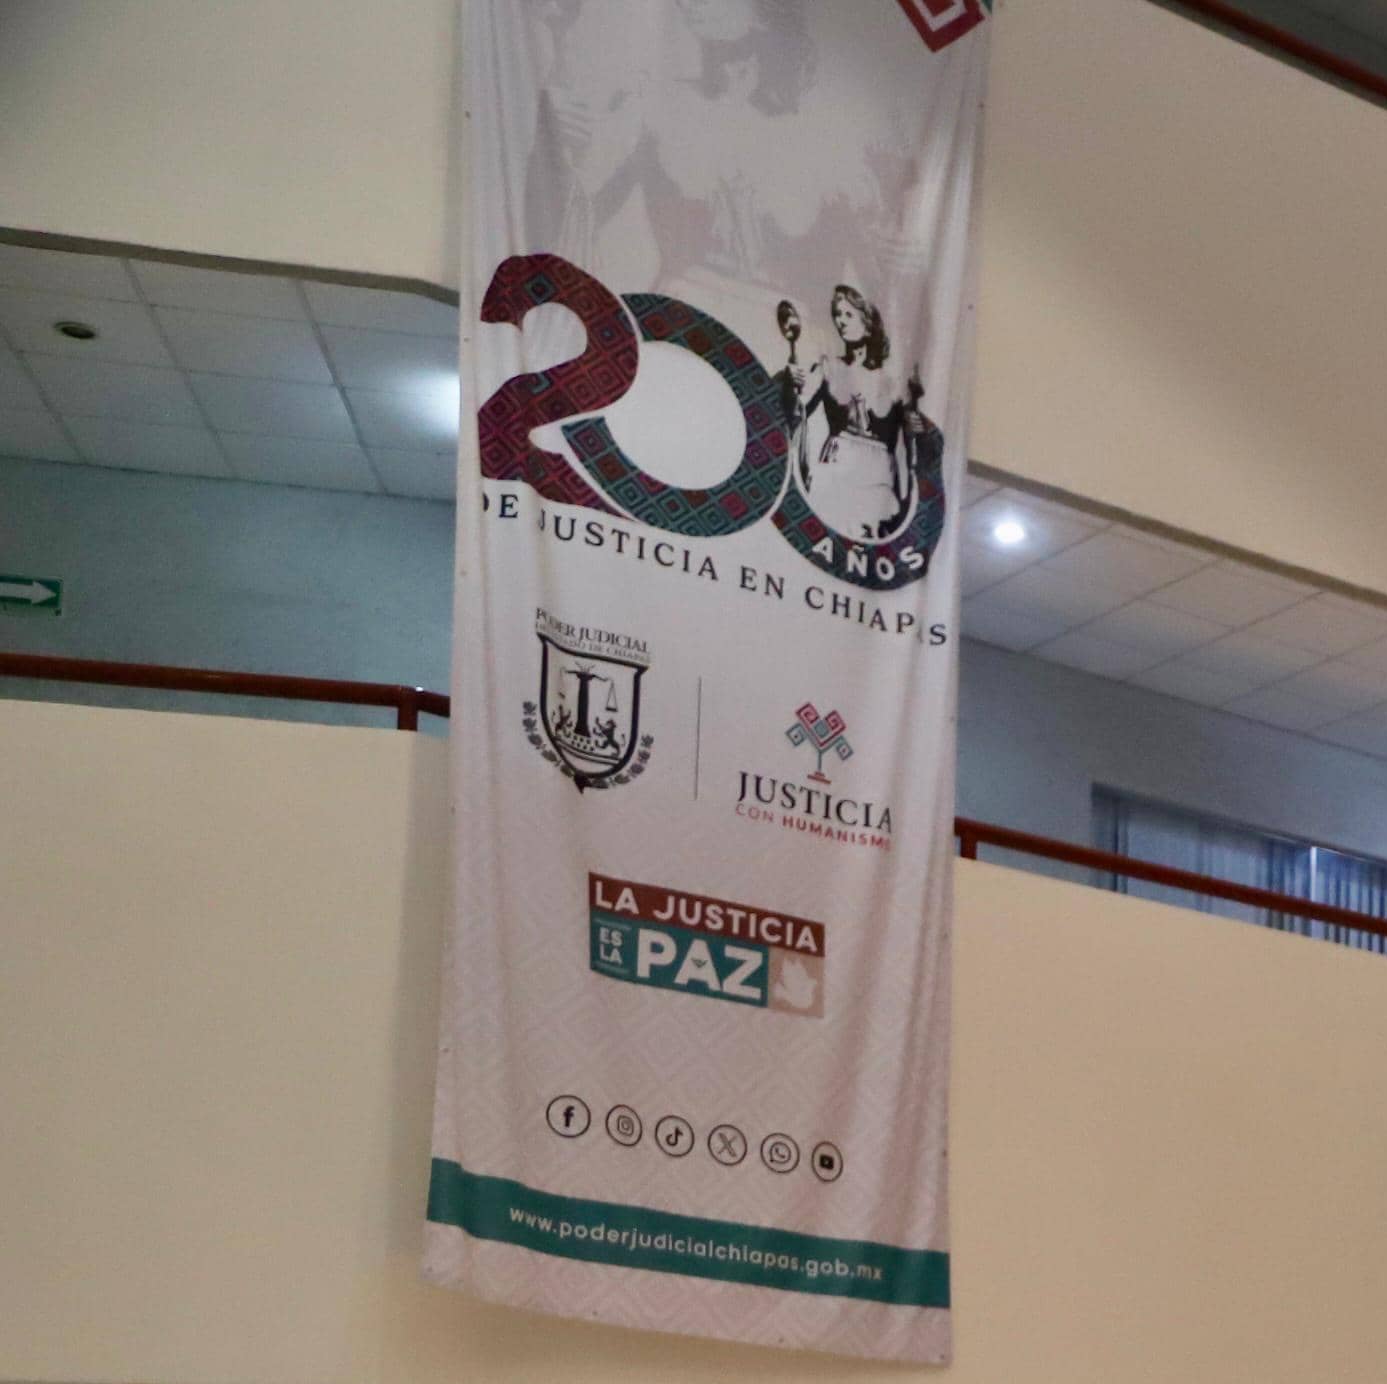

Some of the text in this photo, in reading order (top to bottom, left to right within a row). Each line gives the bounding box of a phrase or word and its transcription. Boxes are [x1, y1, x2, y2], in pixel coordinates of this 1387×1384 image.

[812, 537, 924, 581] AÑOS
[740, 566, 785, 599] EN
[804, 586, 947, 646] CHIAPS
[735, 803, 774, 822] CON
[738, 771, 893, 833] JUSTICIA
[595, 880, 817, 952] LA JUSTICIA
[600, 927, 623, 946] ES
[600, 944, 622, 964] LA
[637, 928, 763, 999] PAZ
[510, 1207, 883, 1281] www.poderjudicialchiapas.gob.mx
